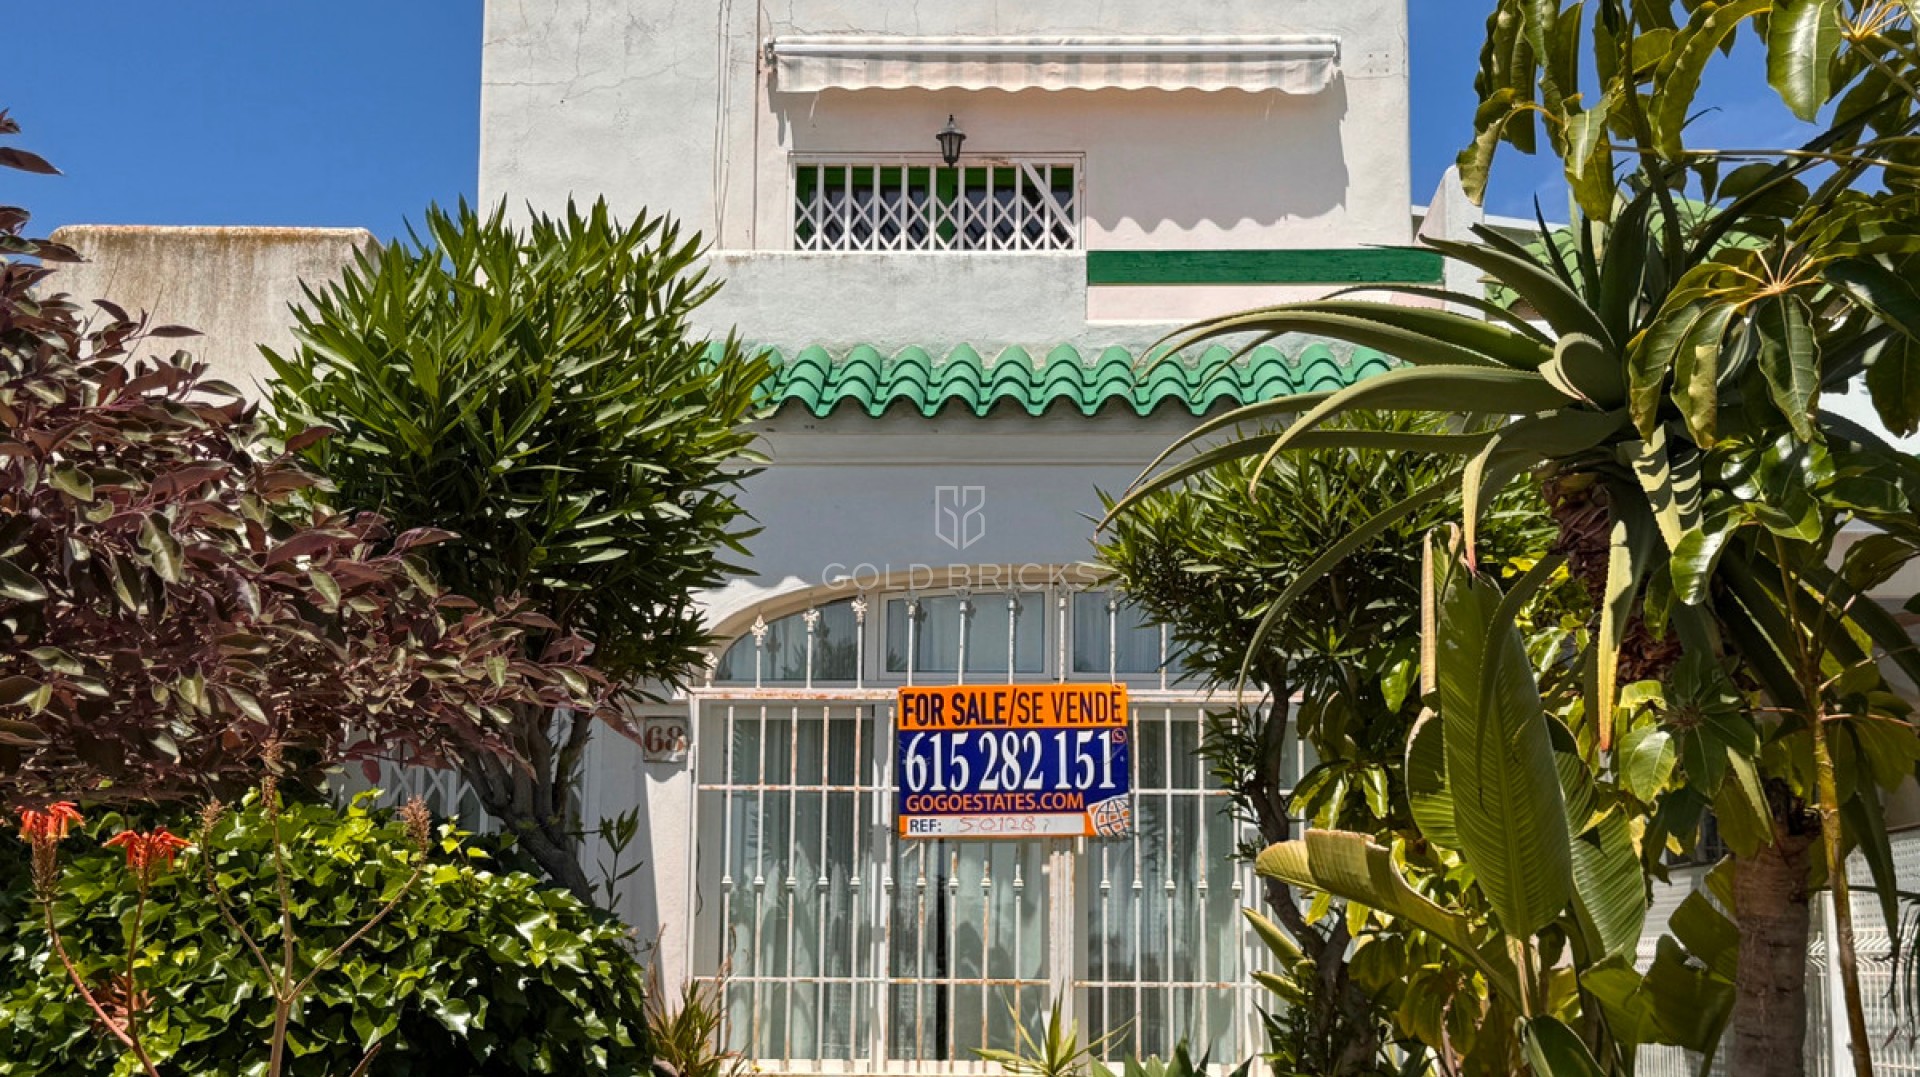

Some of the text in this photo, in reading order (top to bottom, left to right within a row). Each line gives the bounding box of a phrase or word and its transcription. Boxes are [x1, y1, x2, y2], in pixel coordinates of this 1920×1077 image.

[902, 688, 1123, 727] FOR SALE/SE VENDE
[646, 725, 686, 753] 68
[905, 729, 1117, 793] 615 282 151
[906, 792, 1085, 812] GOGOESTATES.COM
[909, 818, 942, 833] REF:
